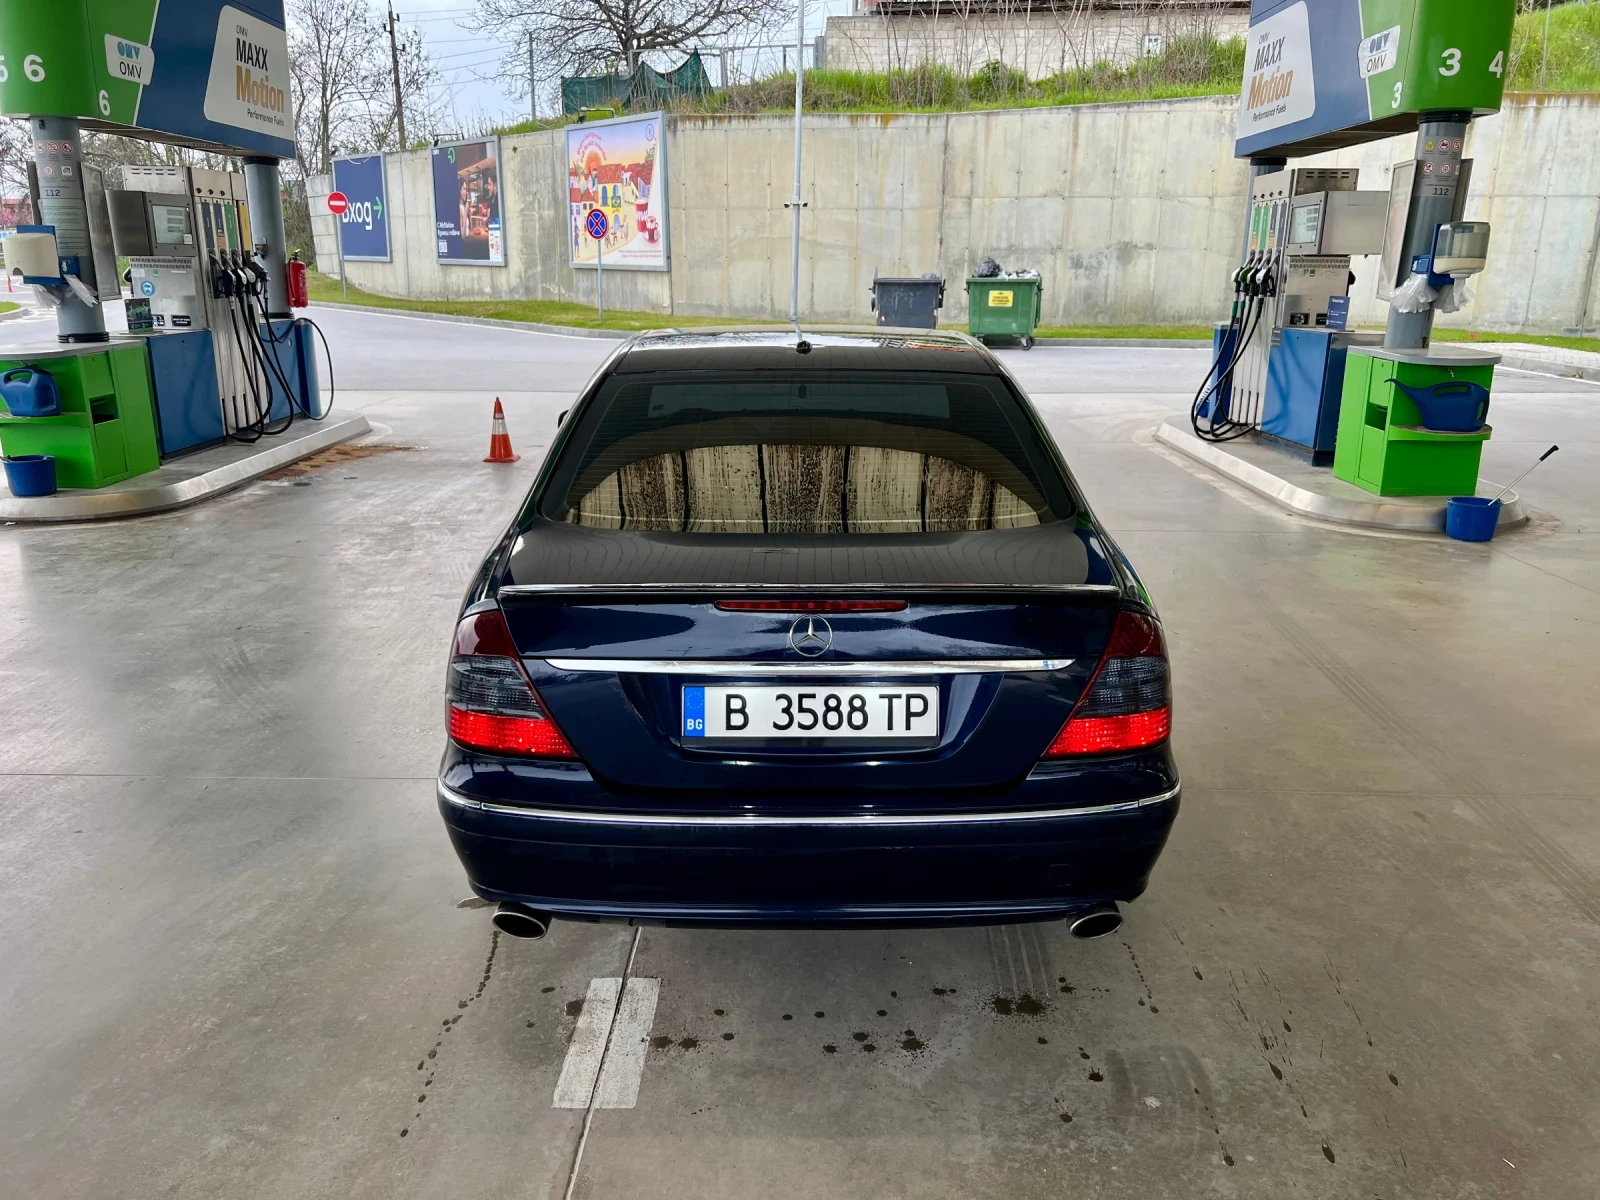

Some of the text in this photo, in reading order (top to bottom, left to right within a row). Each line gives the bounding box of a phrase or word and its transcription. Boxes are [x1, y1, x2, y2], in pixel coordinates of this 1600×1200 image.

[236, 37, 269, 72] MAXX
[1253, 36, 1286, 73] MAXX
[1366, 54, 1387, 73] OMV
[1438, 47, 1504, 79] 3 4
[23, 54, 46, 83] 6
[119, 61, 142, 79] OMV
[236, 65, 285, 114] Motion
[1247, 65, 1294, 111] Motion
[1391, 81, 1403, 109] 3
[98, 89, 111, 116] 6
[1252, 102, 1287, 122] Performance Fuels
[247, 108, 285, 126] Performance Fuels
[45, 189, 61, 197] 112
[1432, 187, 1450, 196] 112
[686, 718, 703, 730] BG
[725, 693, 929, 731] B 3588 TP
